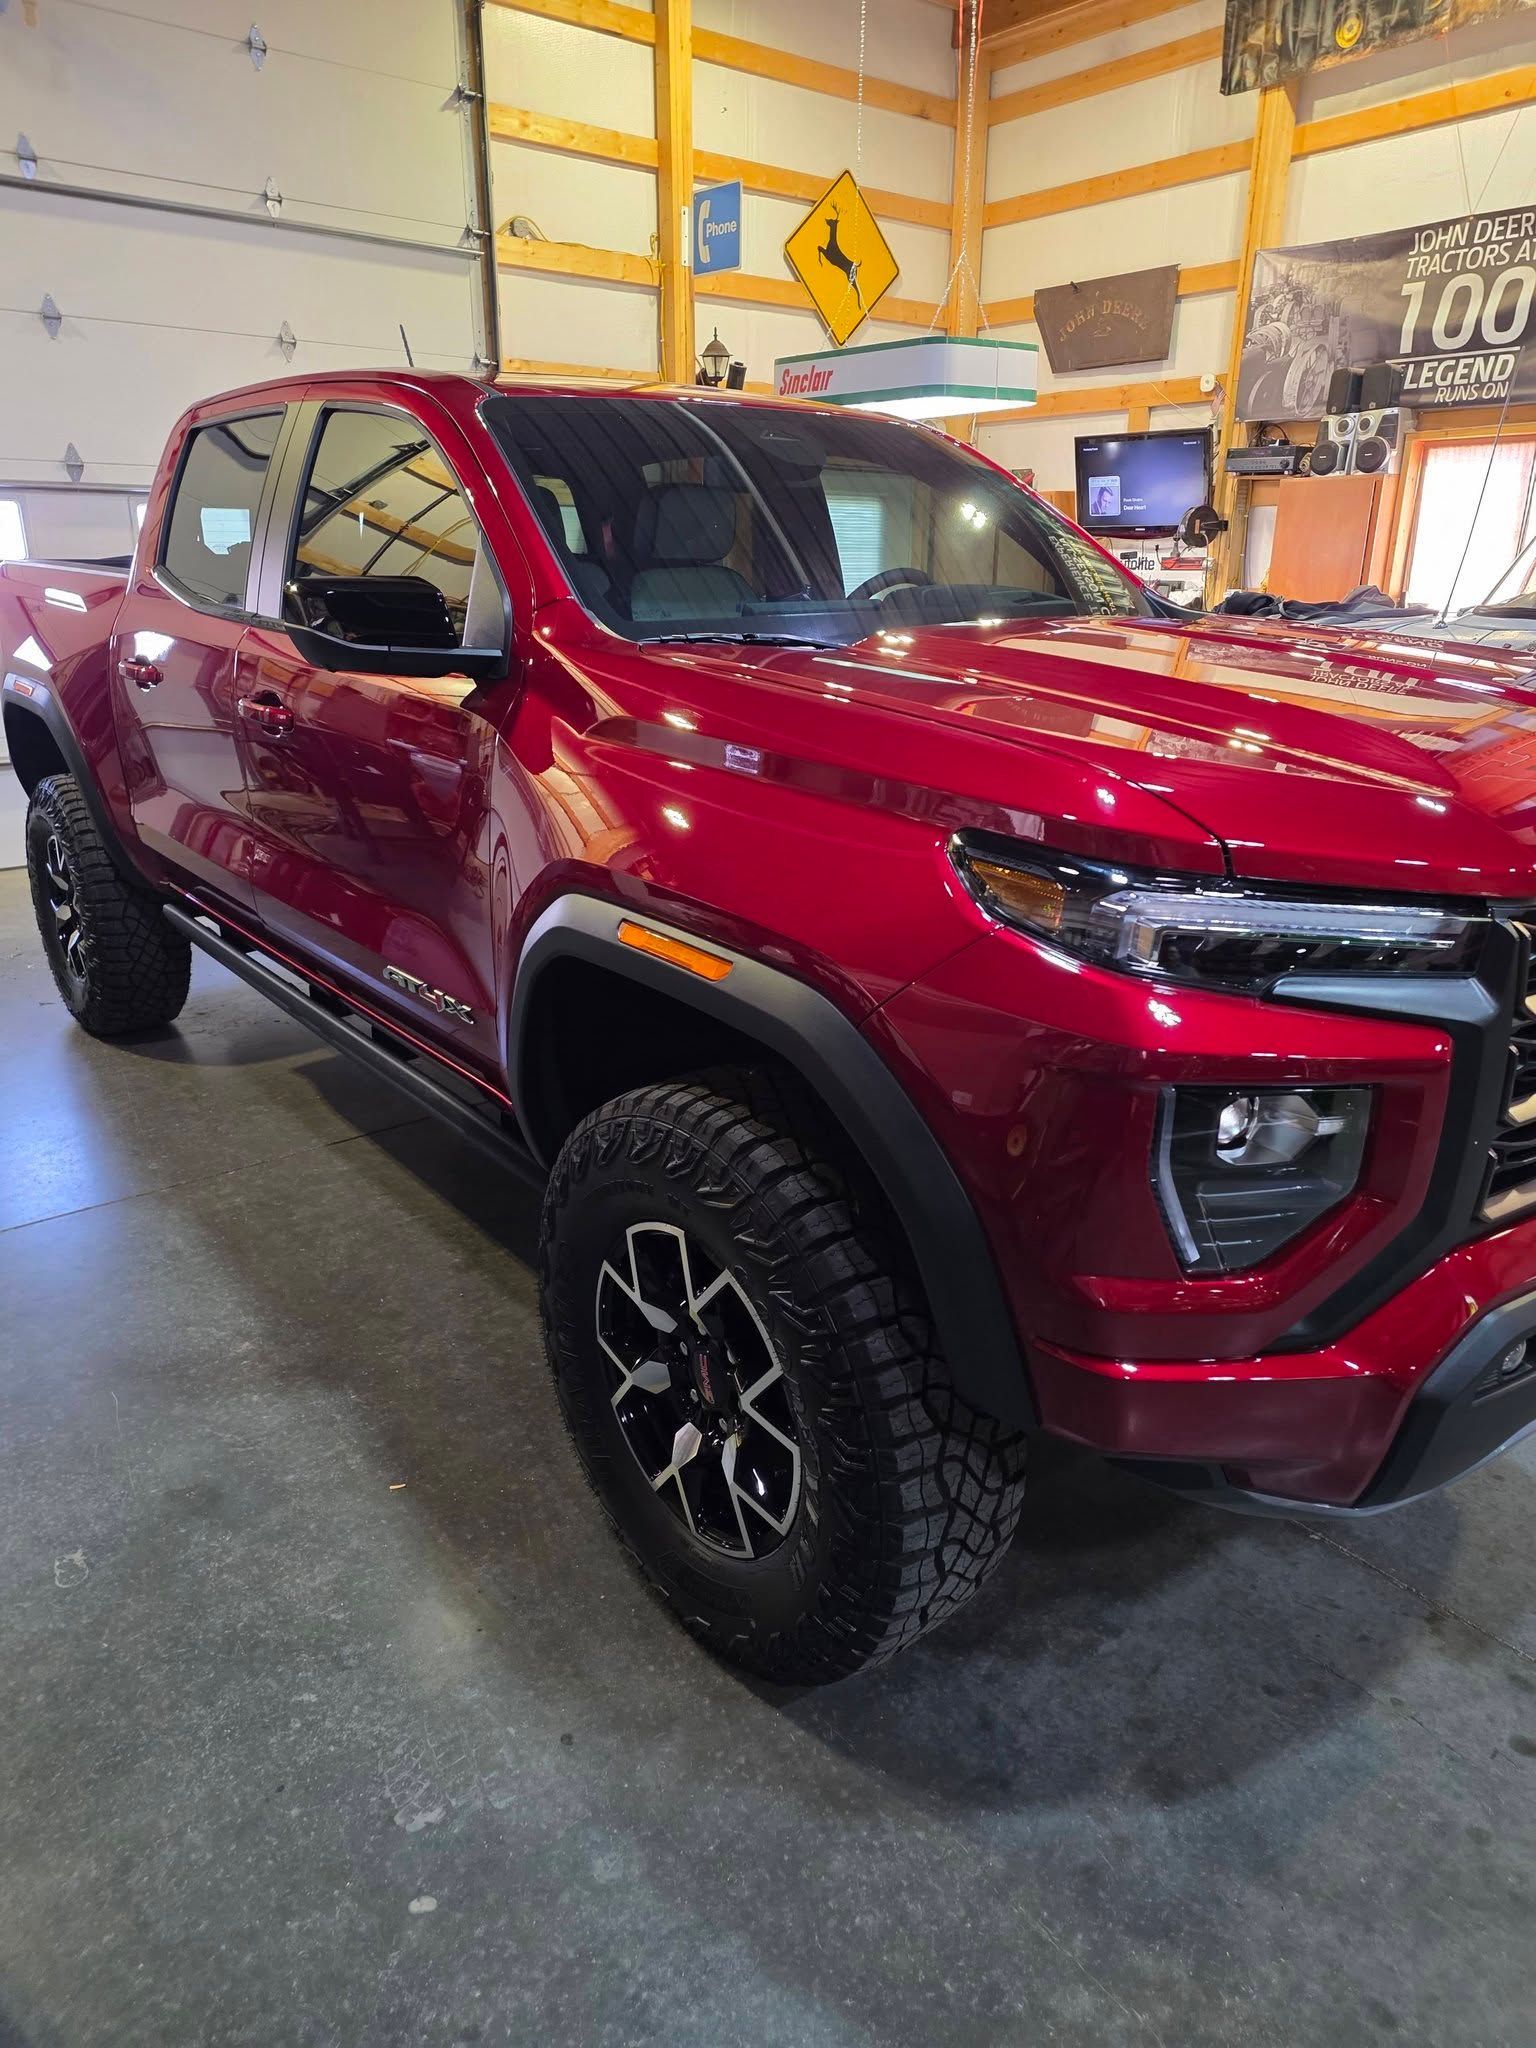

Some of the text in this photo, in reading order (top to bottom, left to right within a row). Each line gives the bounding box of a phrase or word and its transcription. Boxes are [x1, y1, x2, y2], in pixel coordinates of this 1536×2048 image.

[706, 221, 737, 238] Phone
[1408, 212, 1536, 256] JOHN DEER
[1406, 238, 1536, 279] TRACTORS A
[1060, 304, 1096, 342] JOHN
[1399, 266, 1536, 355] 100
[779, 364, 834, 397] Sinclair
[1403, 353, 1515, 390] LEGEND
[1434, 381, 1509, 403] RUNS ON
[382, 964, 475, 1025] AT4X
[698, 1353, 716, 1405] GMC
